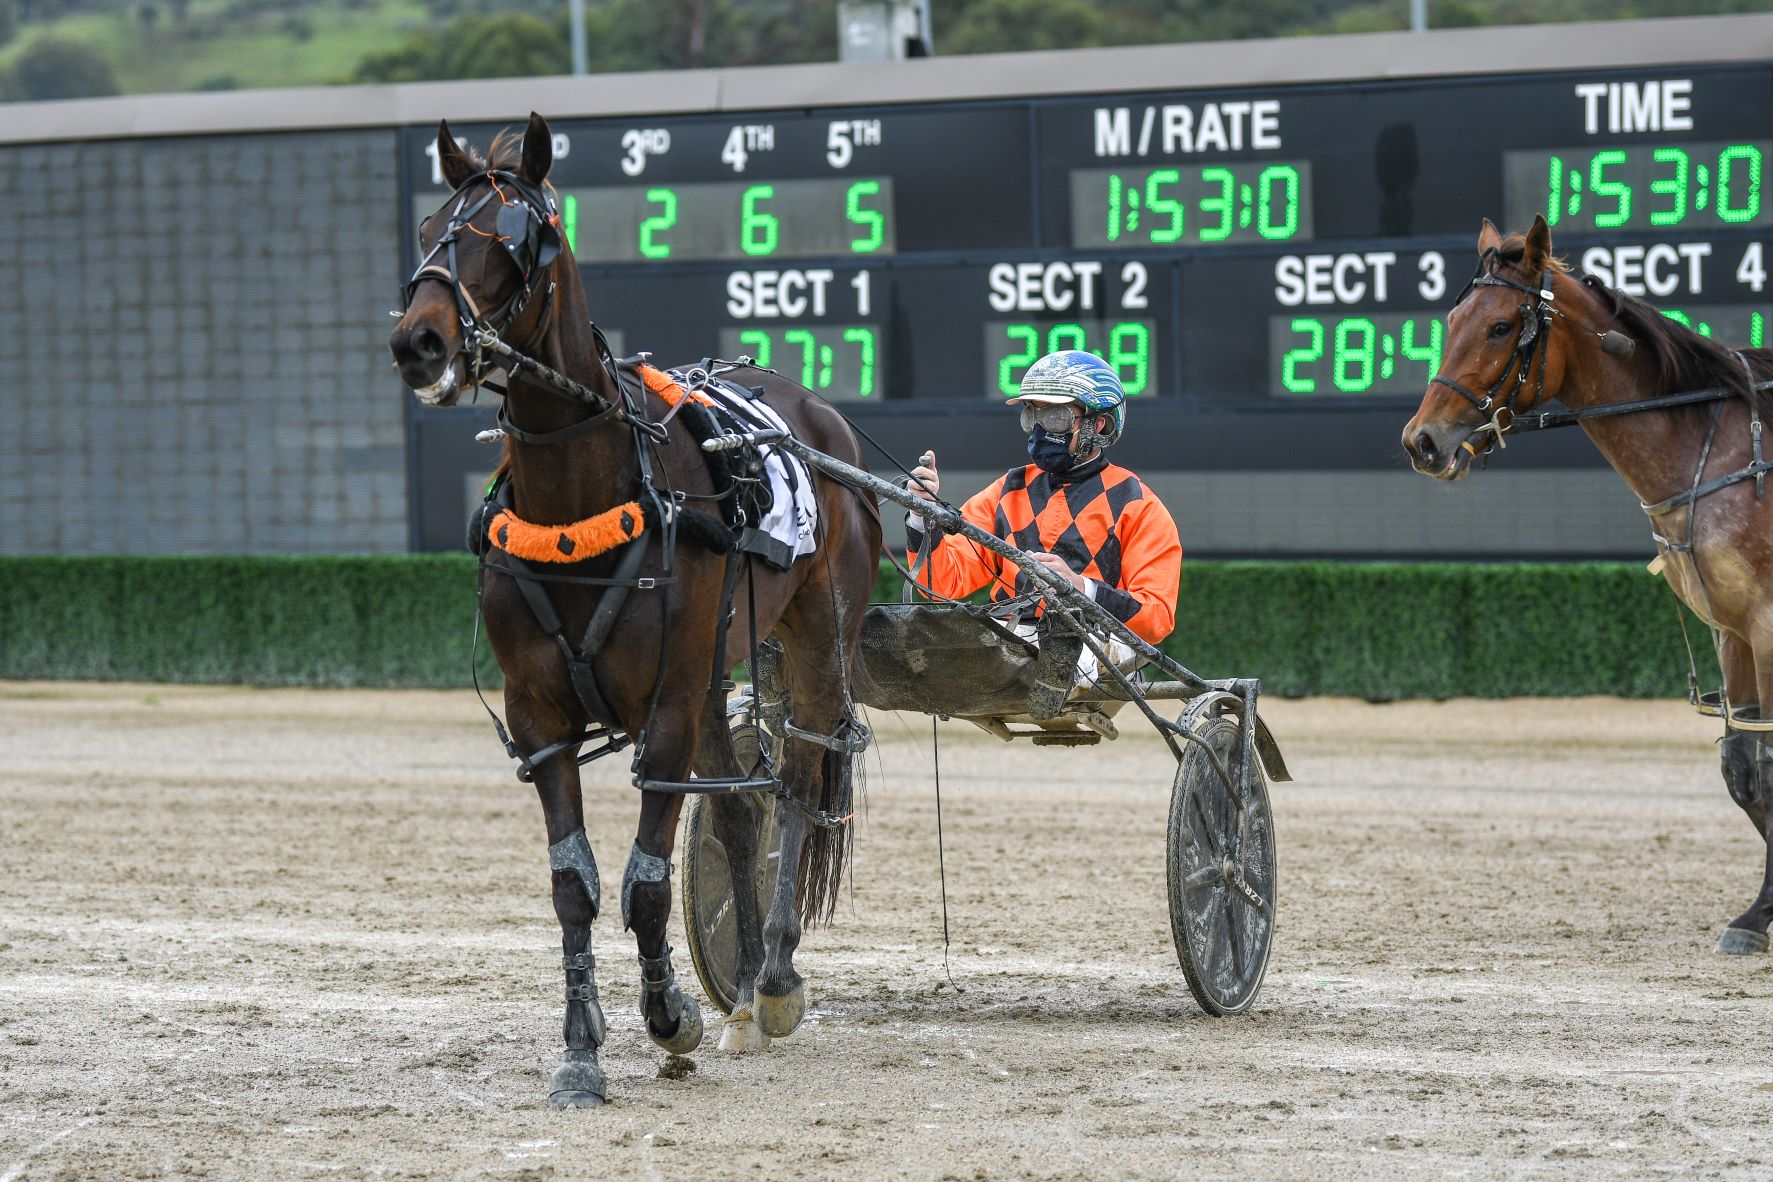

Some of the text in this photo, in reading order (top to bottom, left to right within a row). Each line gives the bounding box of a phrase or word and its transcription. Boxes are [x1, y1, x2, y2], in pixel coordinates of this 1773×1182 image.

[1094, 100, 1282, 157] M/RATE
[1575, 79, 1693, 134] TIME
[621, 128, 671, 176] 3RD
[721, 125, 775, 172] 4TH
[827, 119, 881, 168] 5TH
[1107, 165, 1299, 243] 1:53:0
[1548, 145, 1763, 227] 1:53:0
[640, 189, 677, 258] 2
[741, 186, 779, 255] 6
[847, 181, 884, 252] 5
[726, 269, 870, 318] SECT 1
[989, 261, 1148, 312] SECT 2
[1275, 251, 1446, 306] SECT 3
[1582, 242, 1767, 297] SECT 4
[1283, 317, 1444, 393] 28:4
